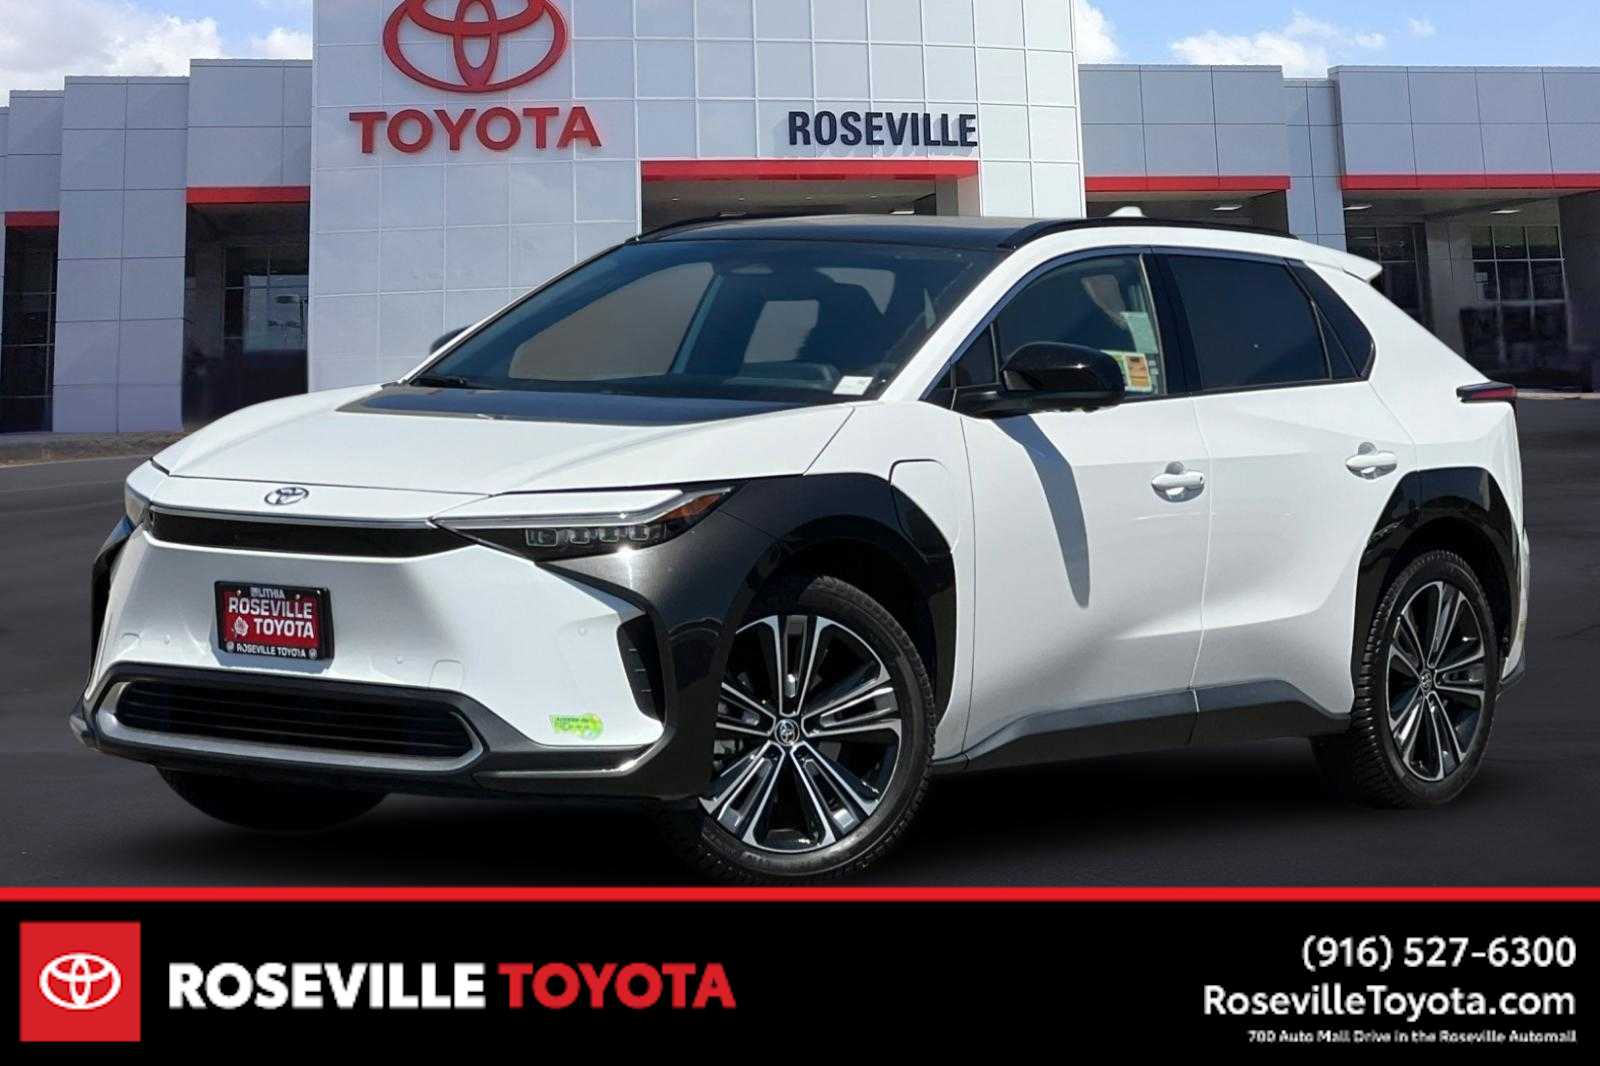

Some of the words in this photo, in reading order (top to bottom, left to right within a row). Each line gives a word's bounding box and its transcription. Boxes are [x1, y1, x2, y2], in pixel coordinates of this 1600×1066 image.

[349, 106, 602, 154] TOYOTA
[788, 110, 978, 147] ROSEVILLE
[228, 597, 313, 619] ROSEVILLE
[254, 618, 315, 639] TOYOTA
[236, 643, 277, 655] ROSEVILLE
[277, 646, 307, 657] TOYOTA
